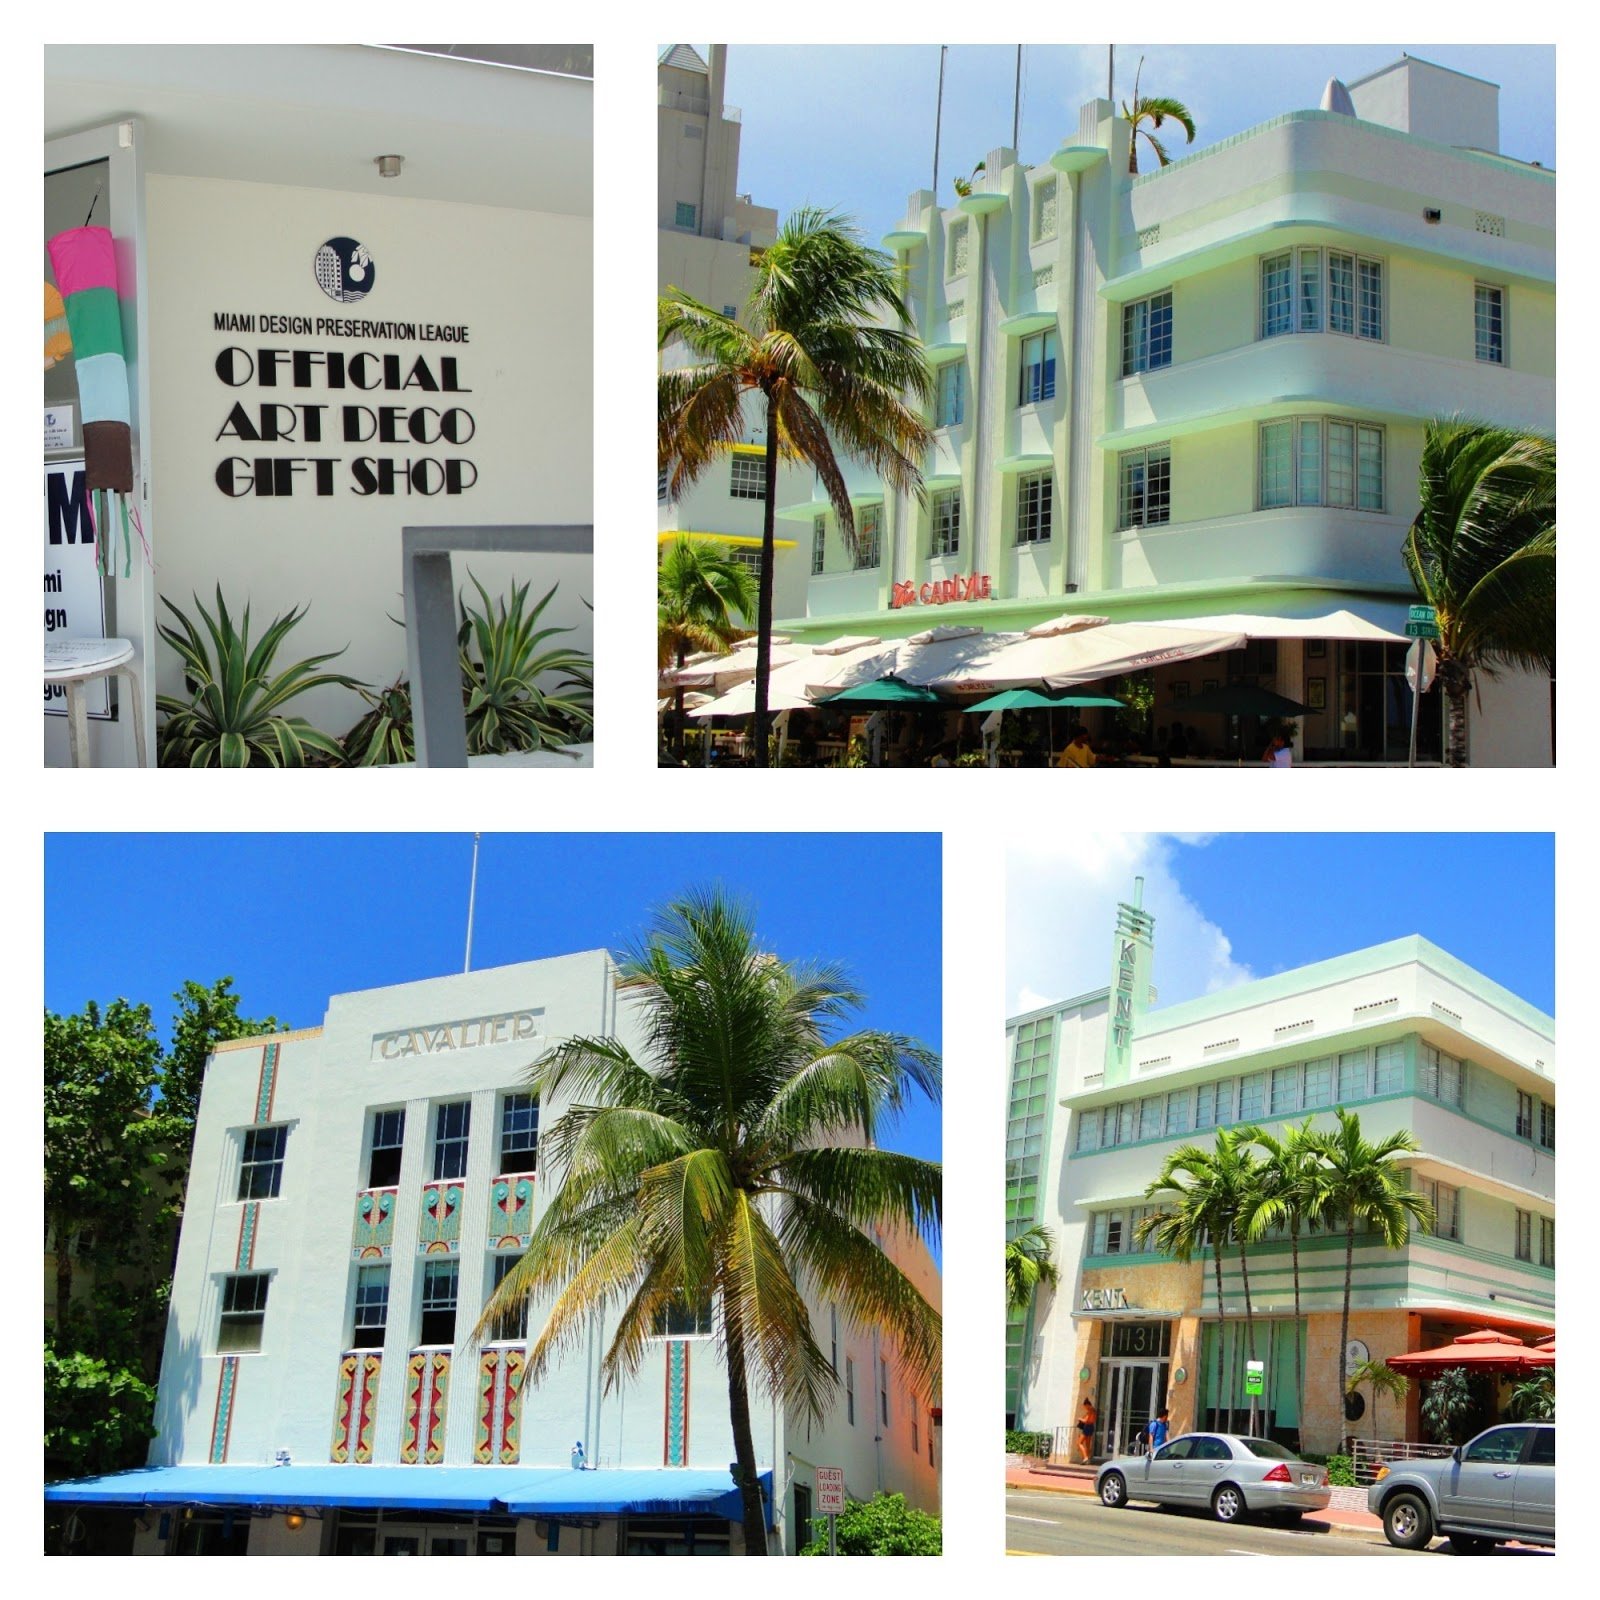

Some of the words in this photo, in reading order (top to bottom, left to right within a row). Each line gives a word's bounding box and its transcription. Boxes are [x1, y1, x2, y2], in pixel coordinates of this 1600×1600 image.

[214, 312, 255, 333] MIAMI
[259, 315, 313, 335] DESIGN
[316, 318, 416, 341] PRESERVATION
[419, 324, 470, 343] LEAGUE
[215, 346, 473, 393] OFFICIAL
[215, 401, 329, 442] ART
[342, 405, 476, 445] DECO
[215, 456, 342, 498] GIFT
[350, 456, 478, 496] SHOP
[44, 471, 95, 545] M
[920, 572, 992, 605] CARLYLE
[44, 609, 67, 632] gn
[1410, 610, 1426, 619] OCEAN
[1115, 939, 1136, 1049] KENT
[380, 1012, 538, 1060] CAVALIER
[1082, 1287, 1126, 1310] KENT
[1119, 1327, 1154, 1352] 1131
[819, 1471, 841, 1481] GUEST
[819, 1482, 842, 1493] LOADING
[822, 1494, 840, 1504] ZONE
